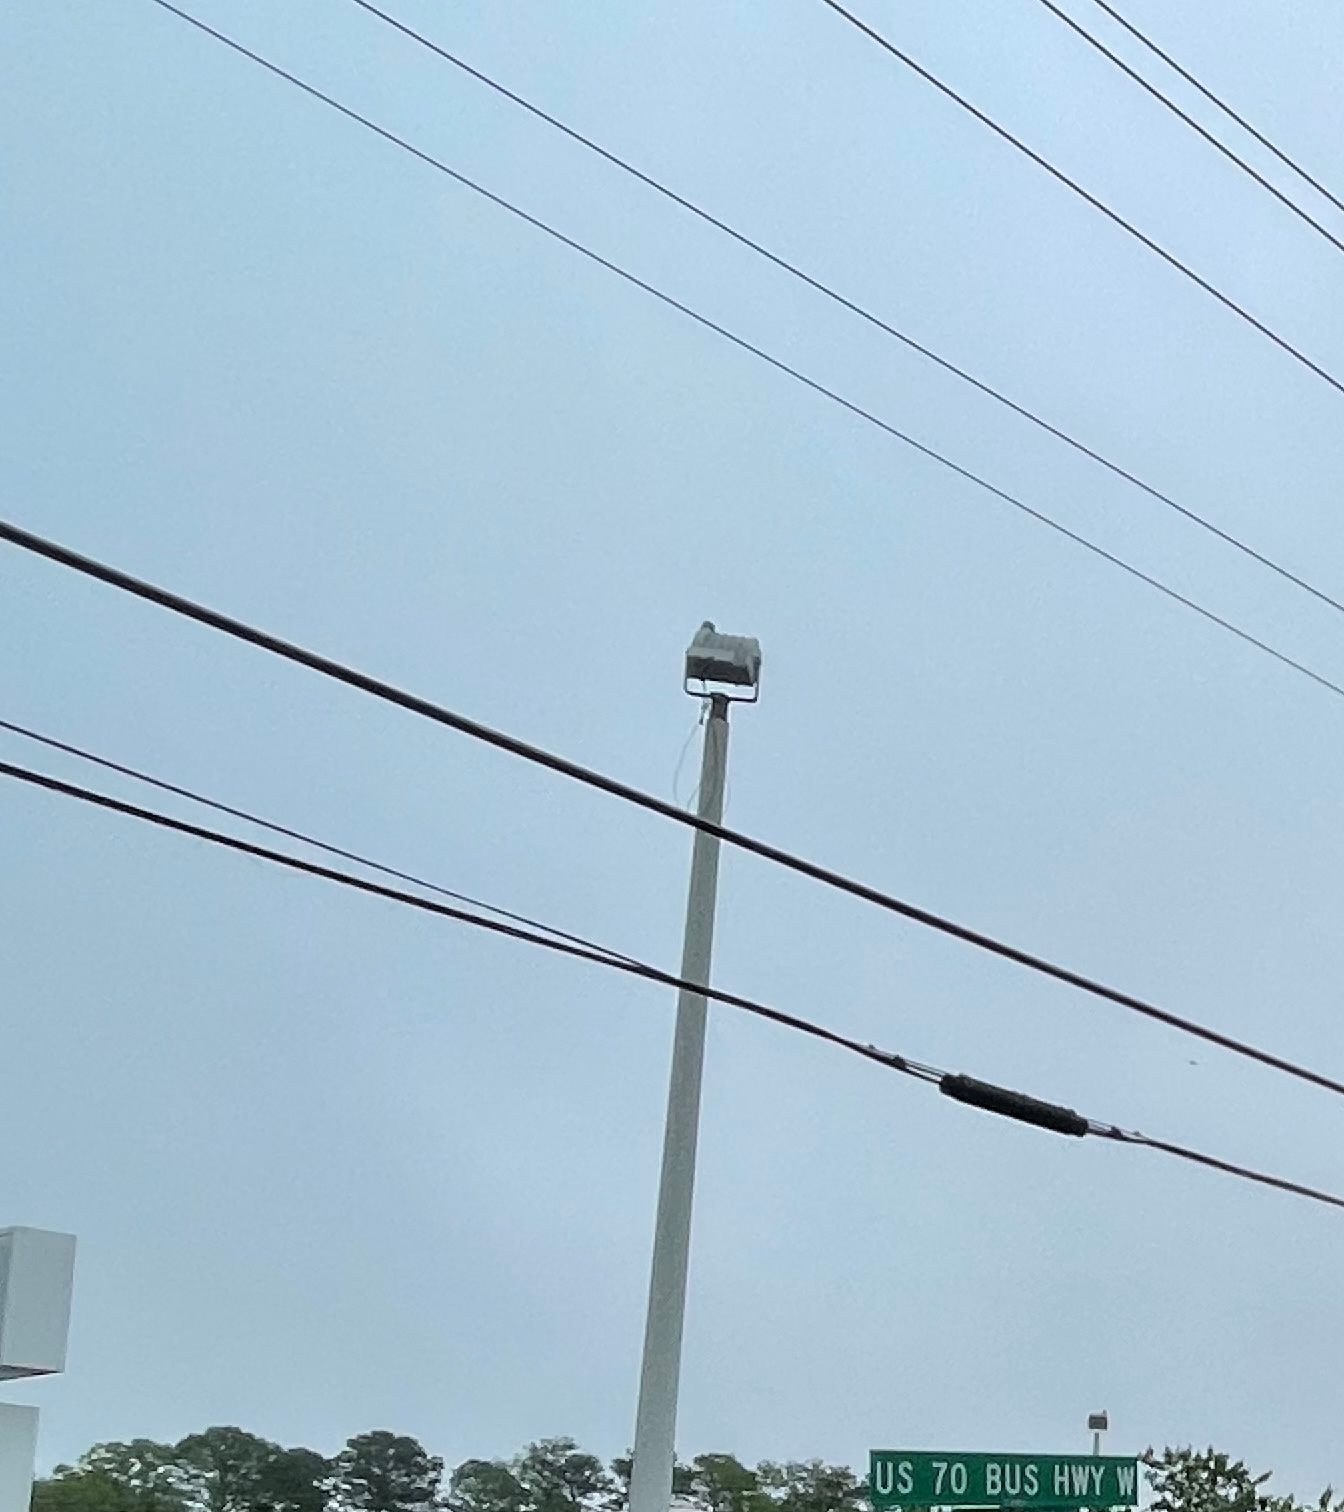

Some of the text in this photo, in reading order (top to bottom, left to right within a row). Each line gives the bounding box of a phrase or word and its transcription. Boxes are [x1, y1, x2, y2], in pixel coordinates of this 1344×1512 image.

[875, 1460, 1135, 1497] US 70 BUS HWY W
